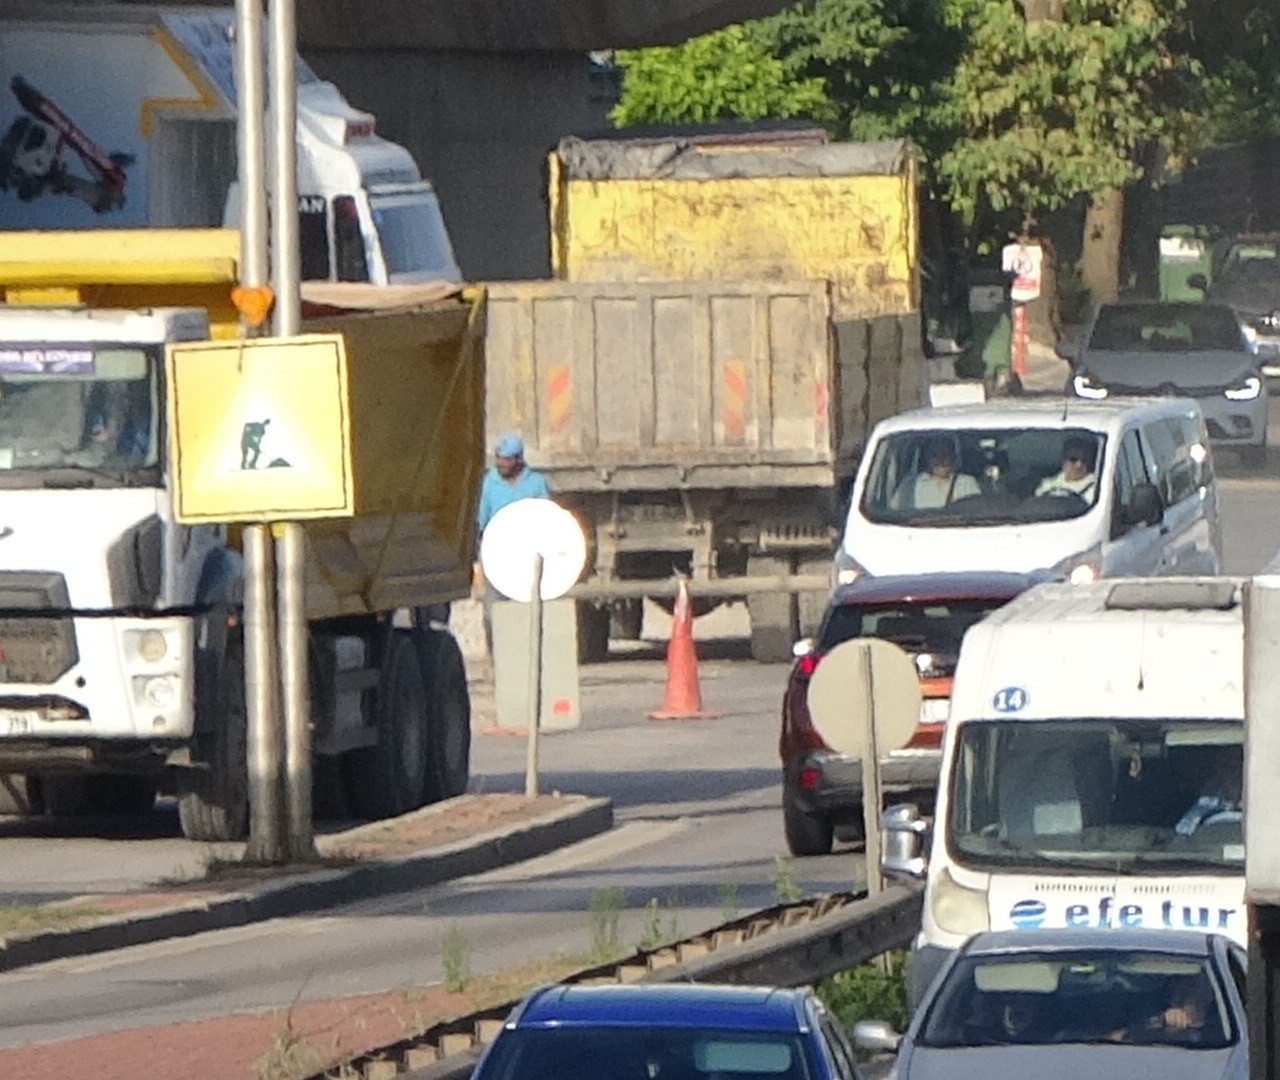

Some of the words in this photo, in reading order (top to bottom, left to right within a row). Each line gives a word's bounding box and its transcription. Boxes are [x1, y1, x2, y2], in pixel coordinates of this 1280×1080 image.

[299, 198, 326, 212] AN
[997, 690, 1022, 710] 14
[1065, 896, 1144, 930] efe
[1162, 900, 1236, 929] tur
